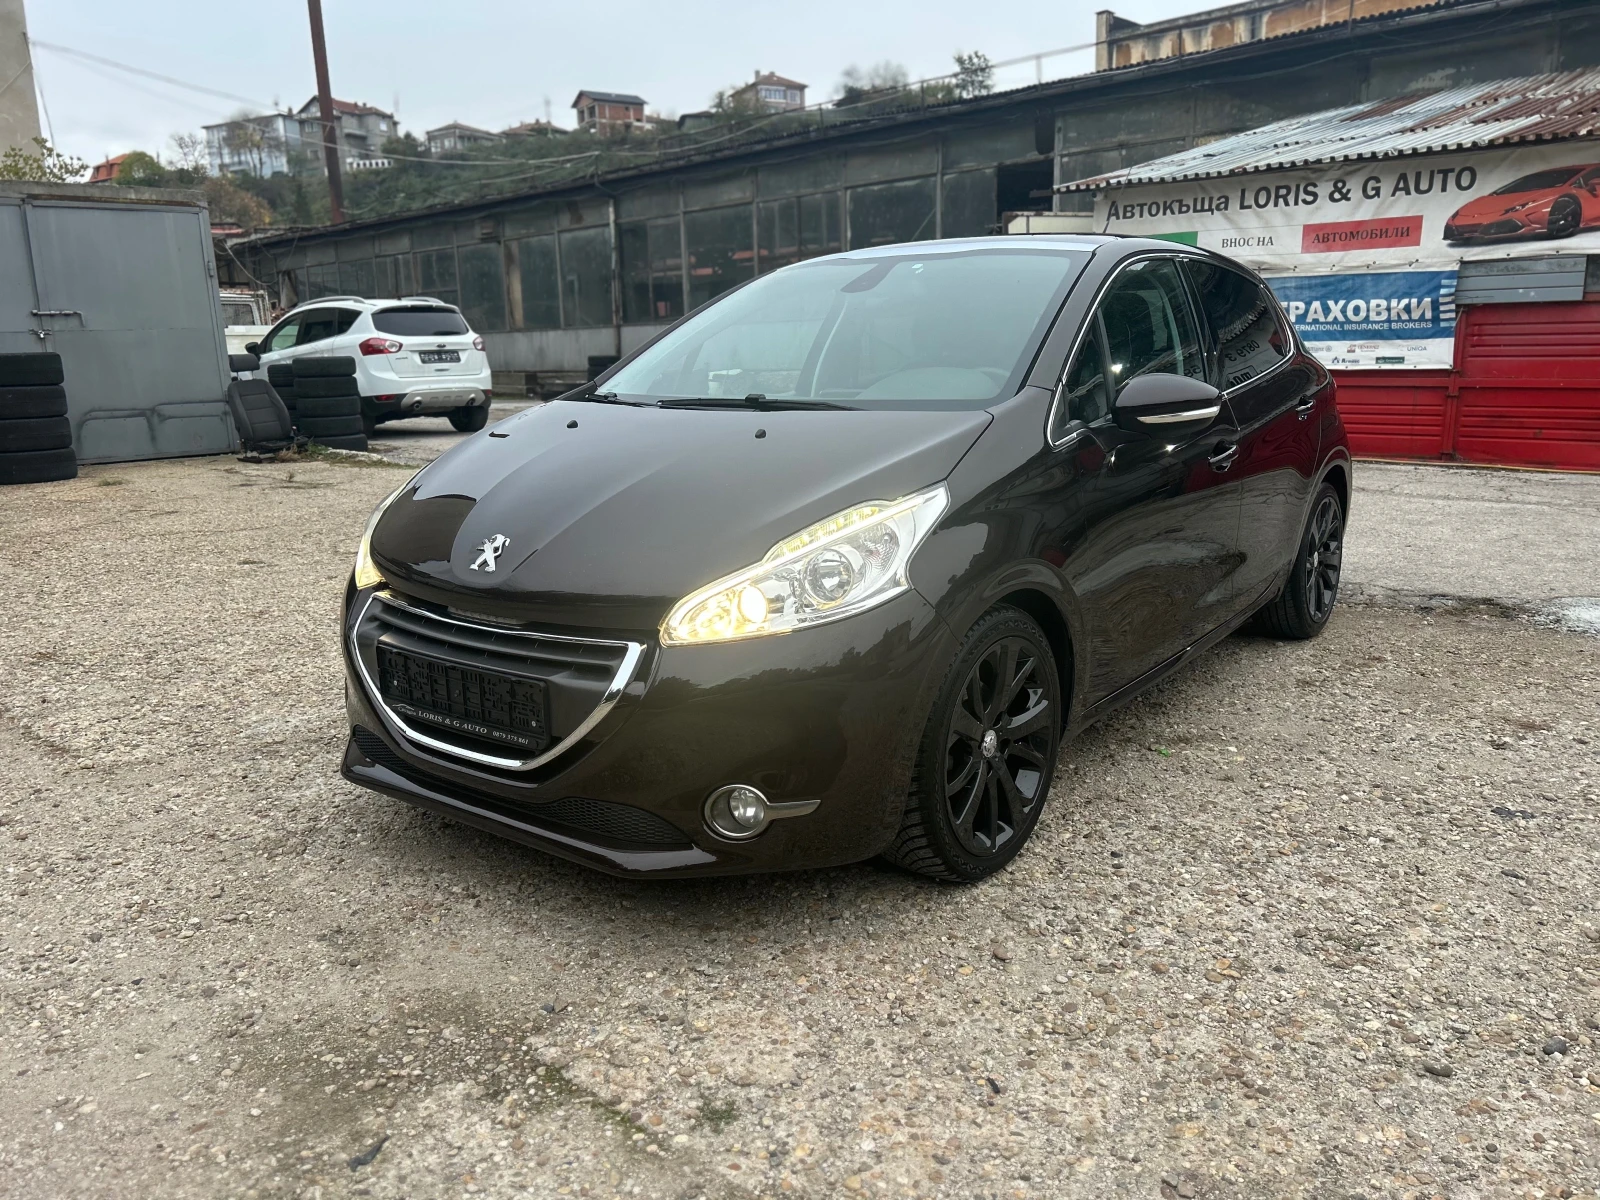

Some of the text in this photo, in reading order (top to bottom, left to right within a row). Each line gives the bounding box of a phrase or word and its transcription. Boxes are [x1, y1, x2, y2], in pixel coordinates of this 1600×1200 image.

[1106, 166, 1477, 221] Автокъща LORIS & G AUTO
[1221, 226, 1411, 248] ВНОС НА АВТОМОБИЛИ
[1294, 321, 1432, 331] ERNATIONAL INSURANCE BROKERS
[418, 711, 443, 723] LORIS
[462, 723, 487, 734] AUTO
